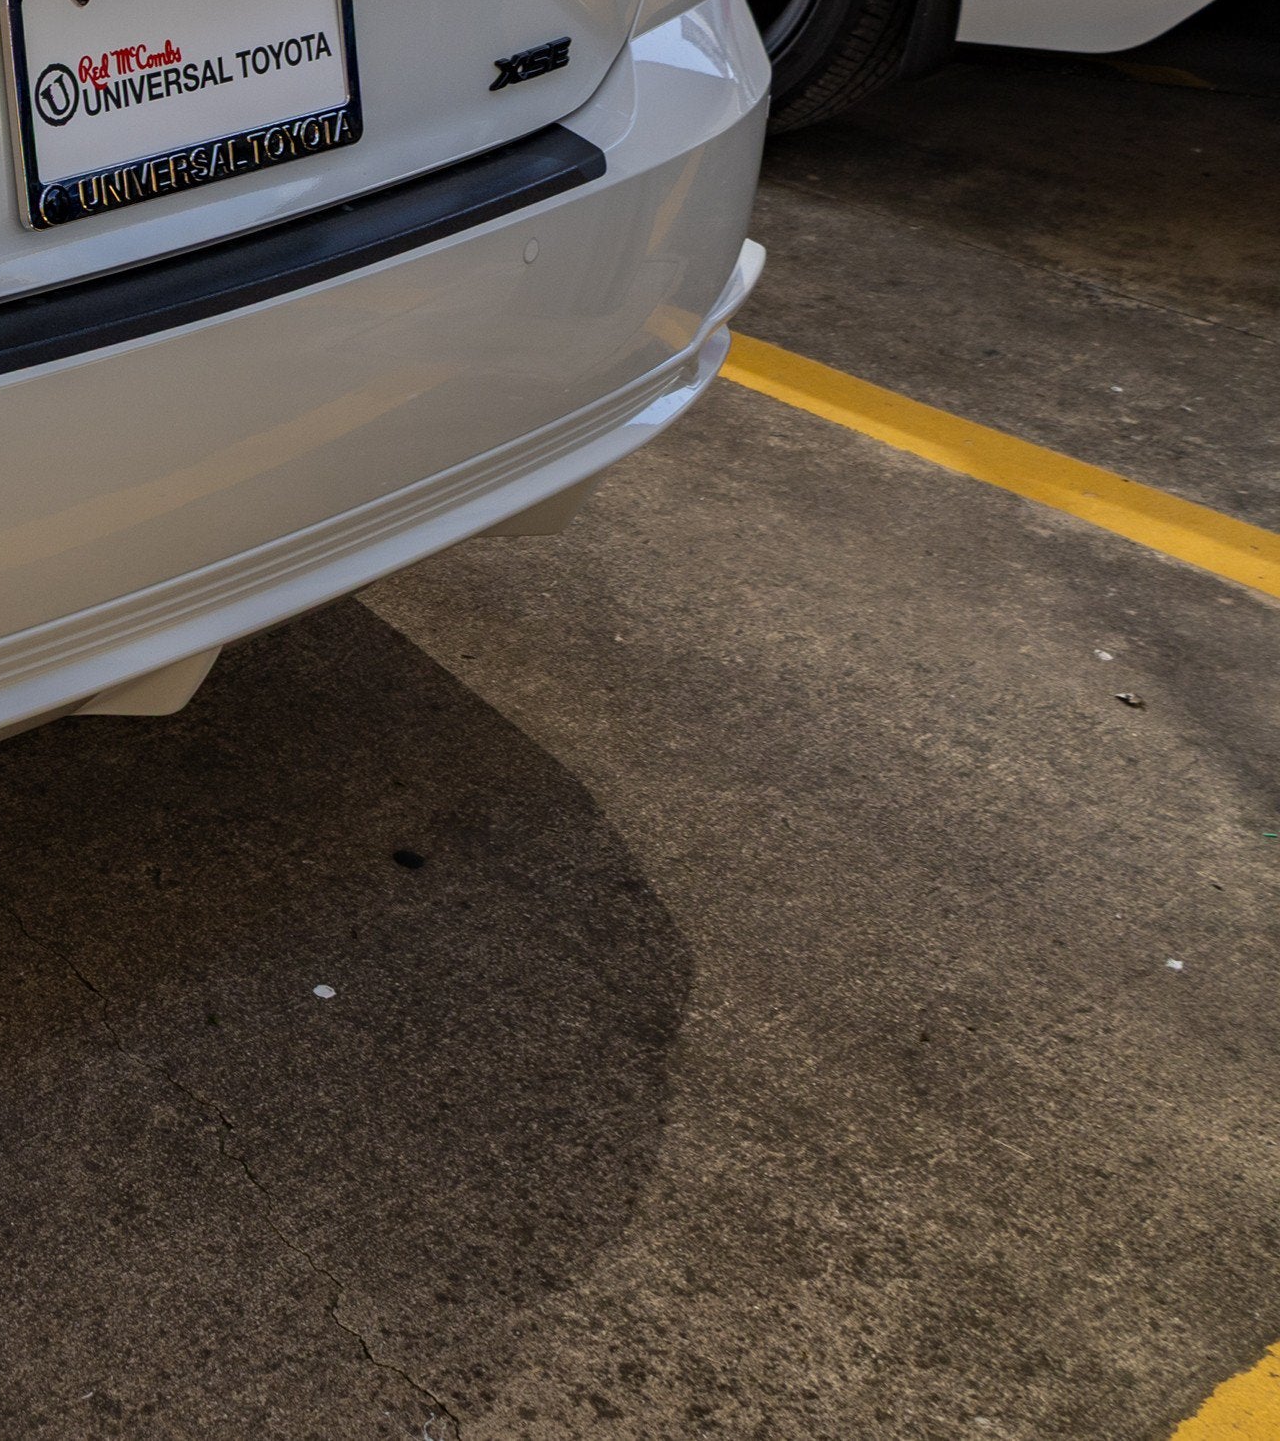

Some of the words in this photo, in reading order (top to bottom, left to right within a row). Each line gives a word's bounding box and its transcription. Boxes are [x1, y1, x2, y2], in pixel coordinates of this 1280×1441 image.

[78, 52, 111, 90] Red
[110, 39, 182, 76] McCombs
[82, 56, 234, 117] UNIVERSAL
[235, 31, 332, 79] TOYOTA
[488, 36, 572, 91] XSE
[78, 138, 249, 211] UNIVERSAL
[246, 109, 354, 165] TOYOTA
